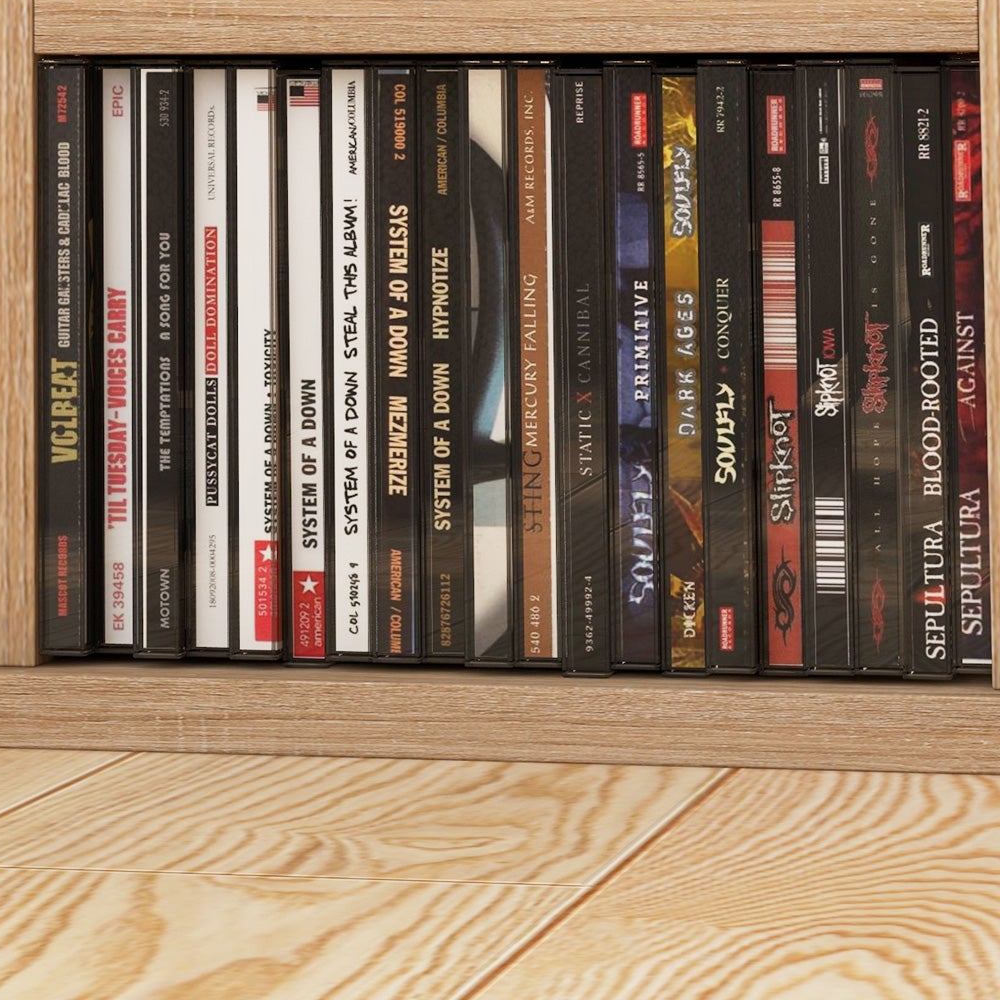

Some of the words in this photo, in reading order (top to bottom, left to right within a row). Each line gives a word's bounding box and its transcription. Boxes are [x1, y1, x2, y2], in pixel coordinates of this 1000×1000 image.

[113, 86, 123, 117] EPIC
[918, 109, 929, 140] 8821-2
[918, 143, 930, 159] RR
[390, 205, 407, 273] SYSTEM
[390, 280, 408, 302] OF
[390, 307, 407, 319] A
[717, 278, 730, 358] CONQUER
[388, 325, 408, 377] DOWN
[302, 379, 316, 430] DOWN
[302, 437, 316, 447] A
[389, 397, 407, 496] MEZMERIZE
[302, 454, 316, 475] OF
[303, 483, 317, 548] SYSTEM
[113, 562, 124, 609] 39458
[113, 613, 124, 630] EK
